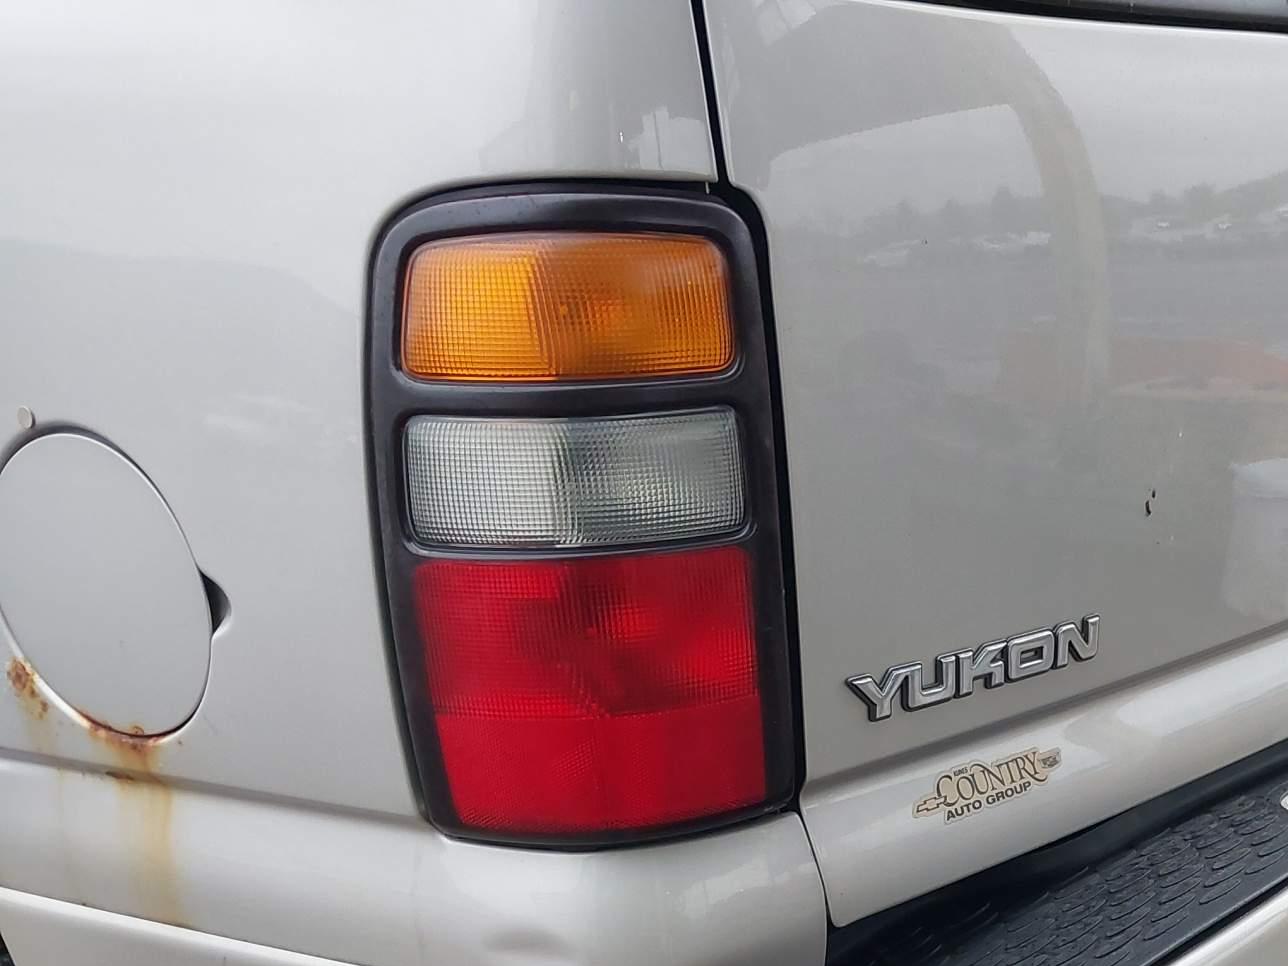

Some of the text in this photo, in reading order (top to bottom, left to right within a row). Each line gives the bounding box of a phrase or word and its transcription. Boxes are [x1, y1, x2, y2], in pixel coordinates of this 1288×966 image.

[845, 613, 1100, 722] YUKON
[936, 751, 1048, 807] COUNTRY
[946, 780, 1032, 822] AUTO GROUP
